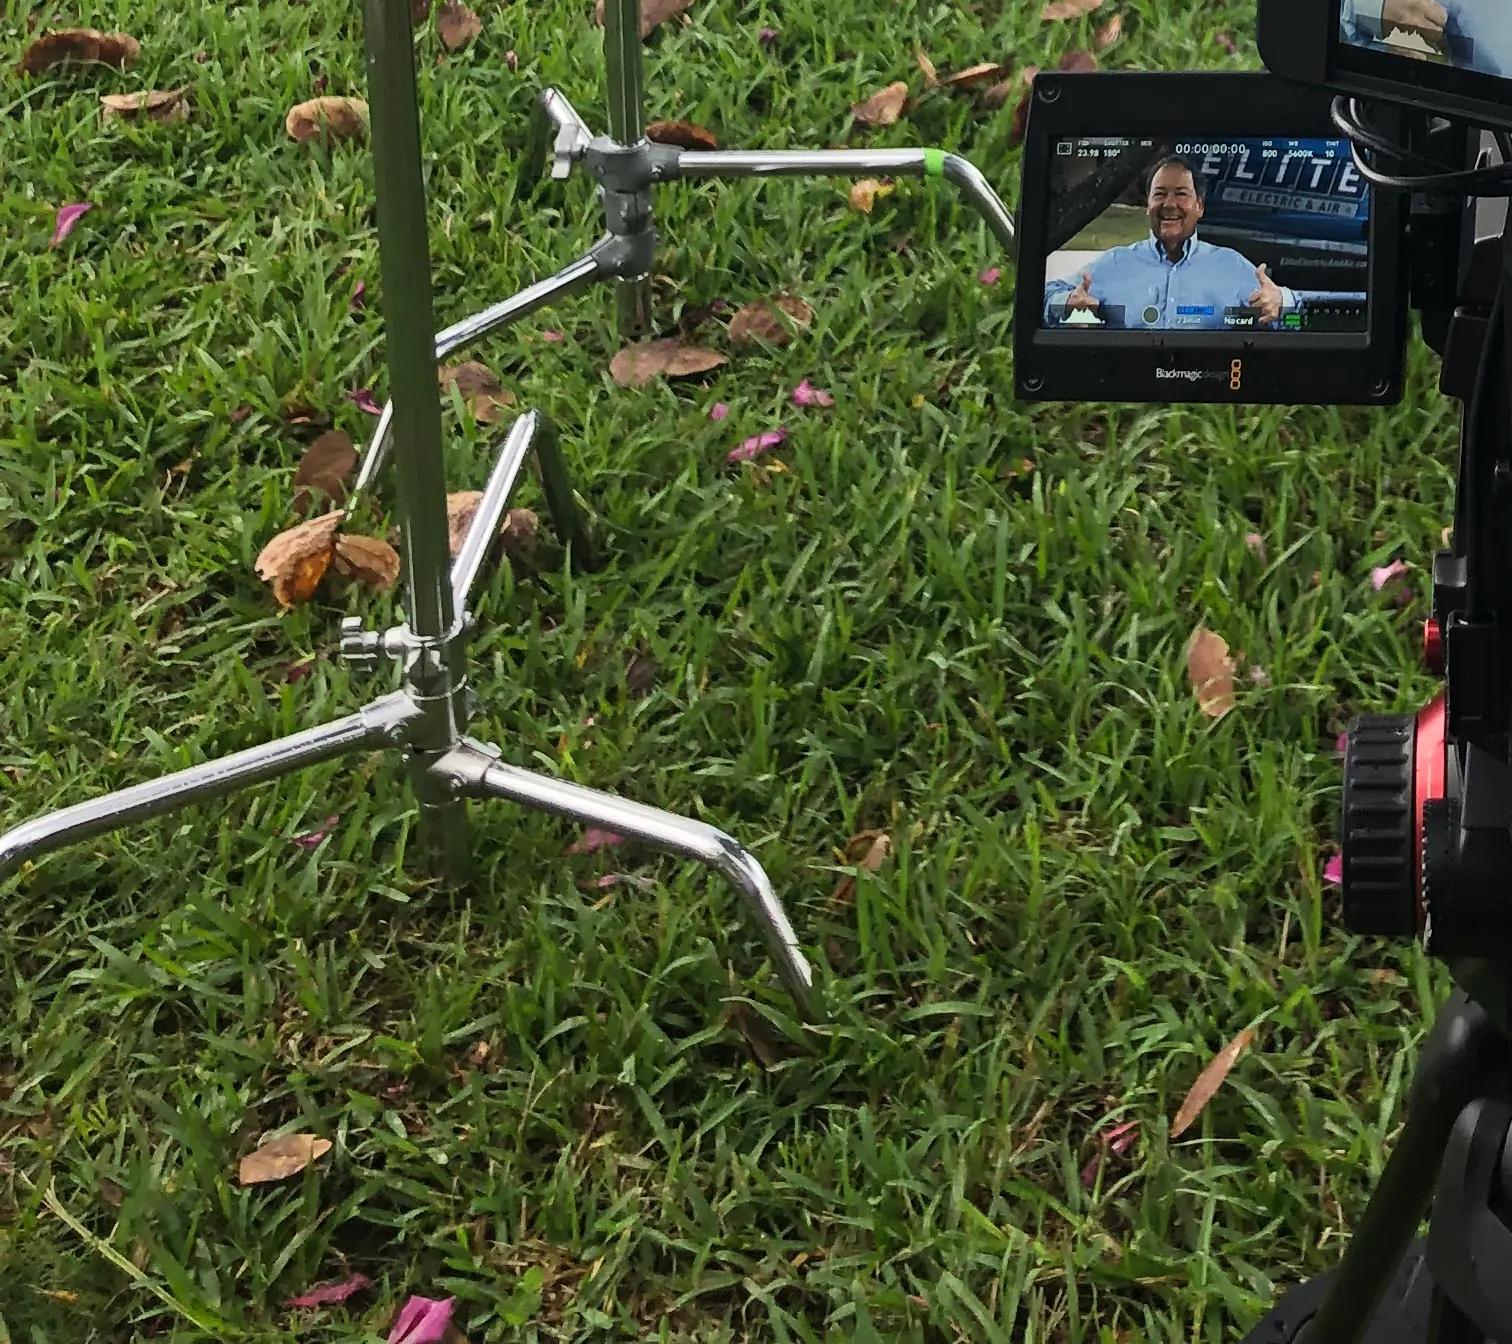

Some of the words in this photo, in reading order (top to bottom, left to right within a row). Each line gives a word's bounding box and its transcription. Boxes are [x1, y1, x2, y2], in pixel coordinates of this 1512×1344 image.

[1077, 148, 1099, 157] 23.98
[1175, 143, 1246, 155] 00:00:00:00
[1262, 150, 1278, 158] 800
[1201, 148, 1360, 193] ELITE
[1240, 192, 1299, 208] ELECTRIC
[1224, 316, 1236, 325] No
[1236, 316, 1253, 325] card
